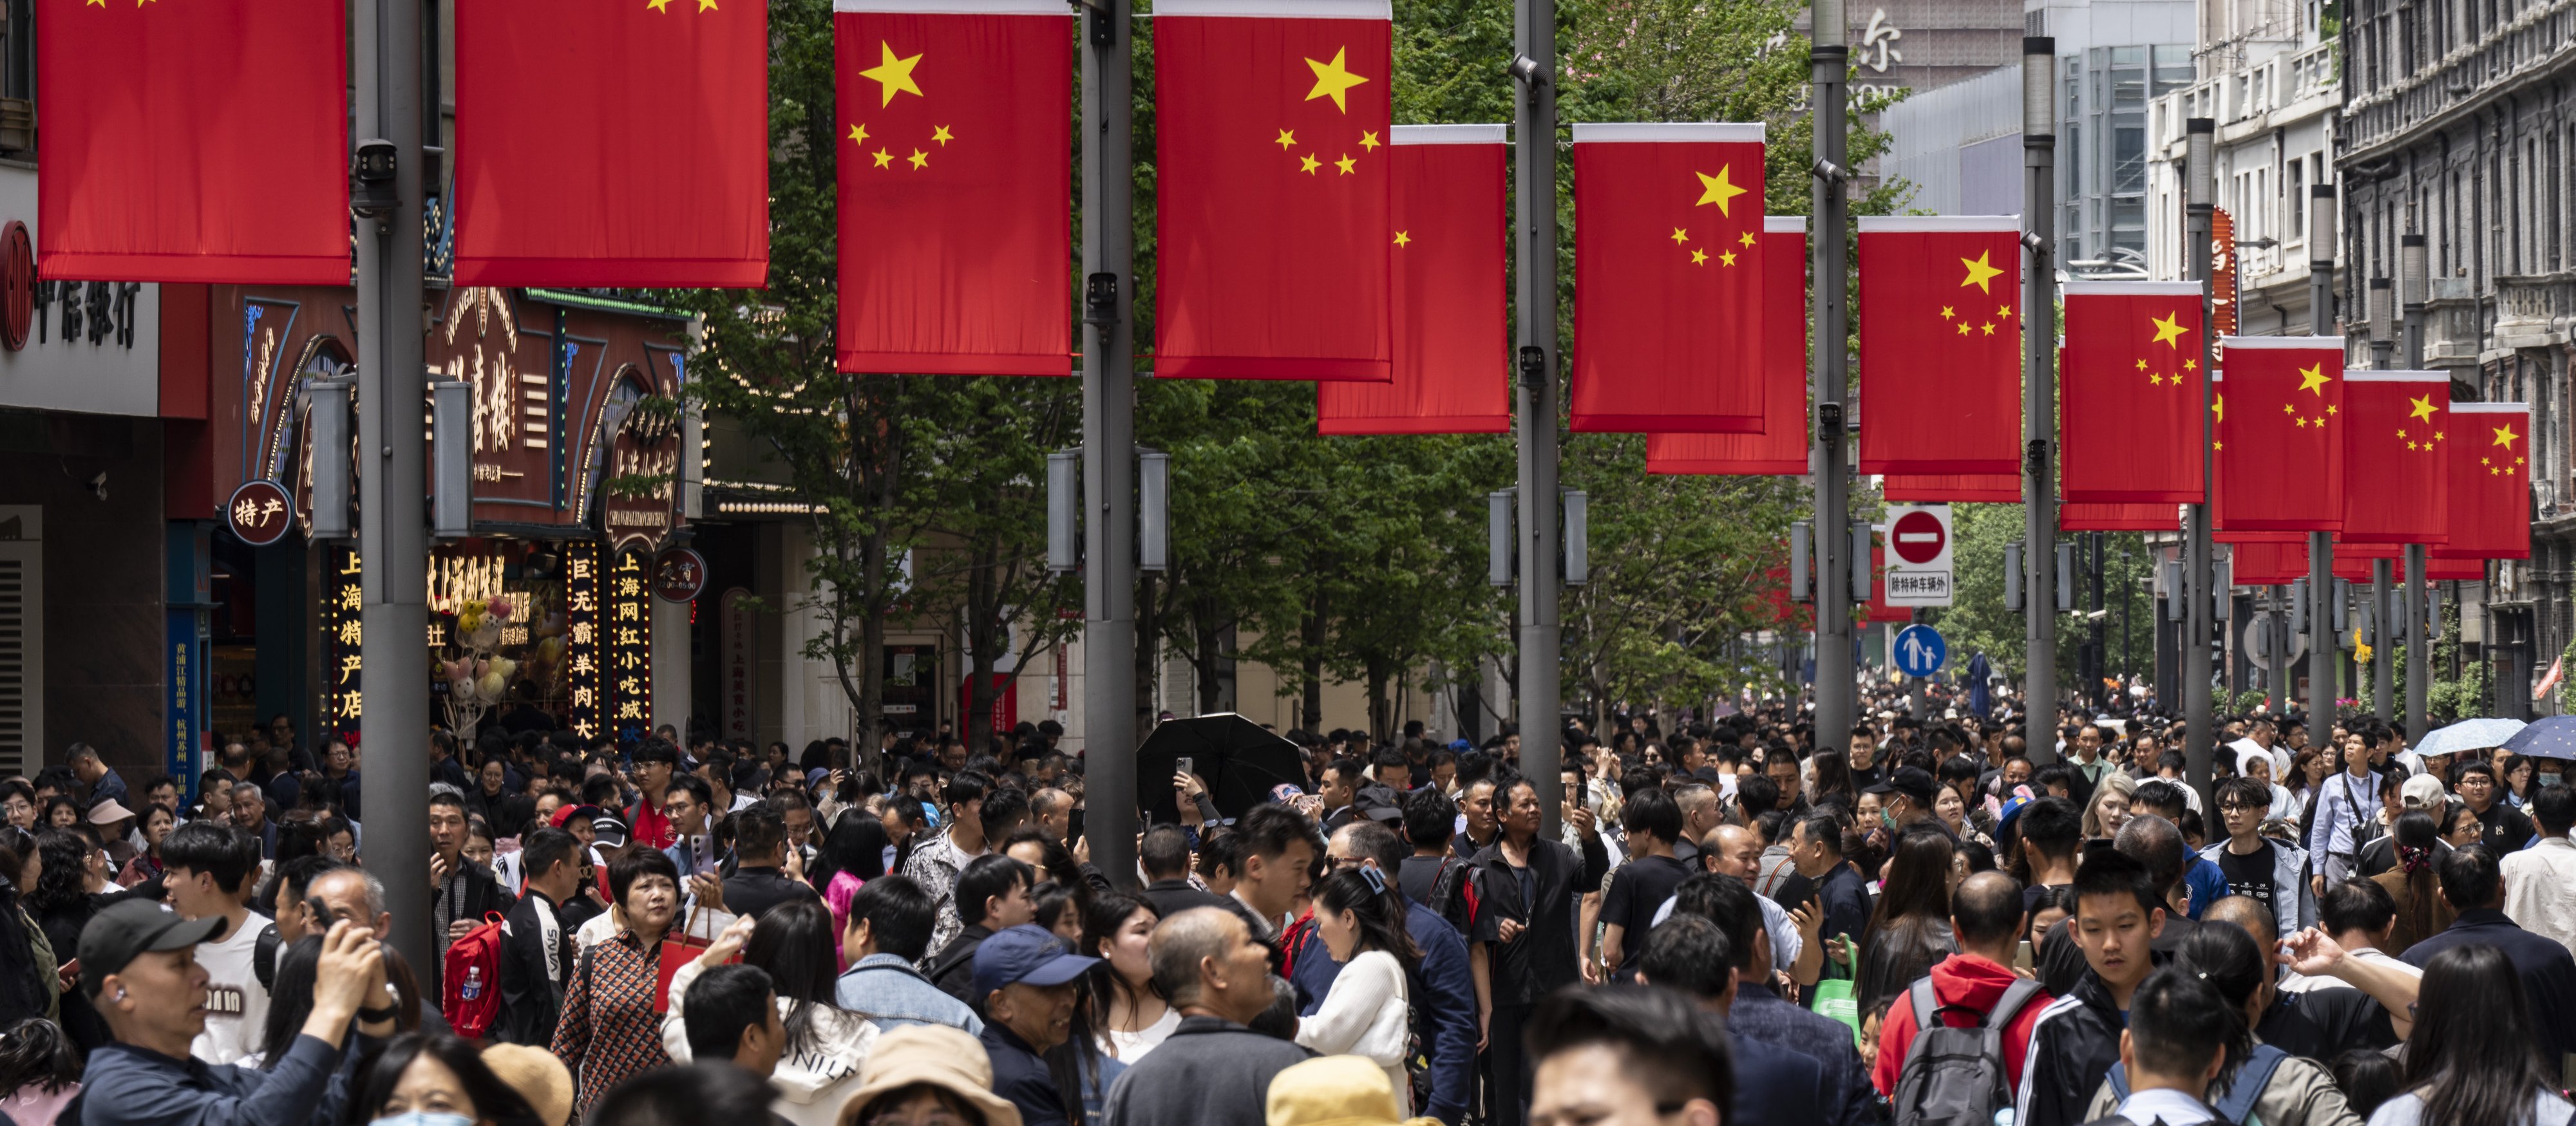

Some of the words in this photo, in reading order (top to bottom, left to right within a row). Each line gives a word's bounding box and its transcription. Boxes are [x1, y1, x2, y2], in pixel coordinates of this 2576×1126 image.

[235, 498, 283, 527] 特产
[659, 560, 695, 582] 夜宵
[1891, 576, 1946, 593] 除特种车辆外
[340, 551, 361, 719] 上海特产店
[620, 553, 642, 720] 上海网红小吃城
[732, 654, 745, 741] 上海美食小吃
[547, 928, 558, 973] VANS
